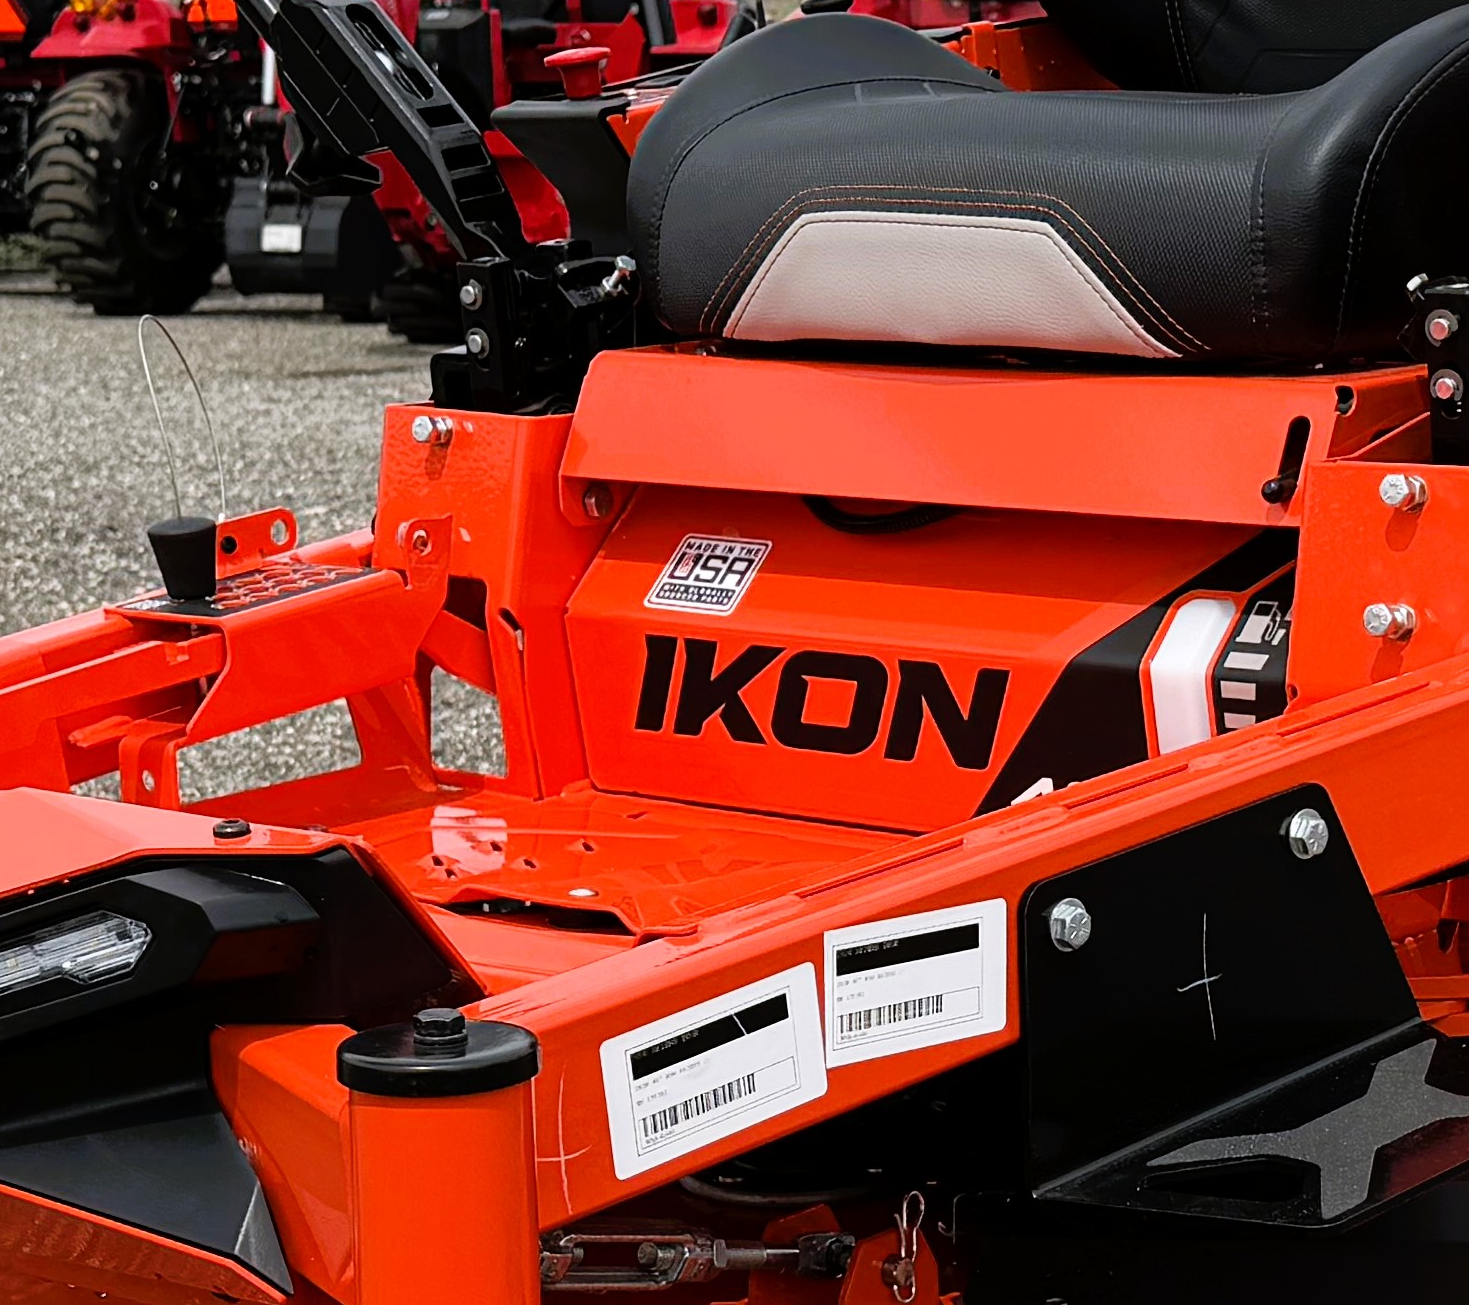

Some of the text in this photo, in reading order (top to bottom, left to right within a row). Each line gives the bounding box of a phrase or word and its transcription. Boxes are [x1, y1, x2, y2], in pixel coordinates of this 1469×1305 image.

[685, 540, 763, 558] MADE IN THE
[667, 551, 756, 587] USA
[633, 633, 1012, 771] IKON
